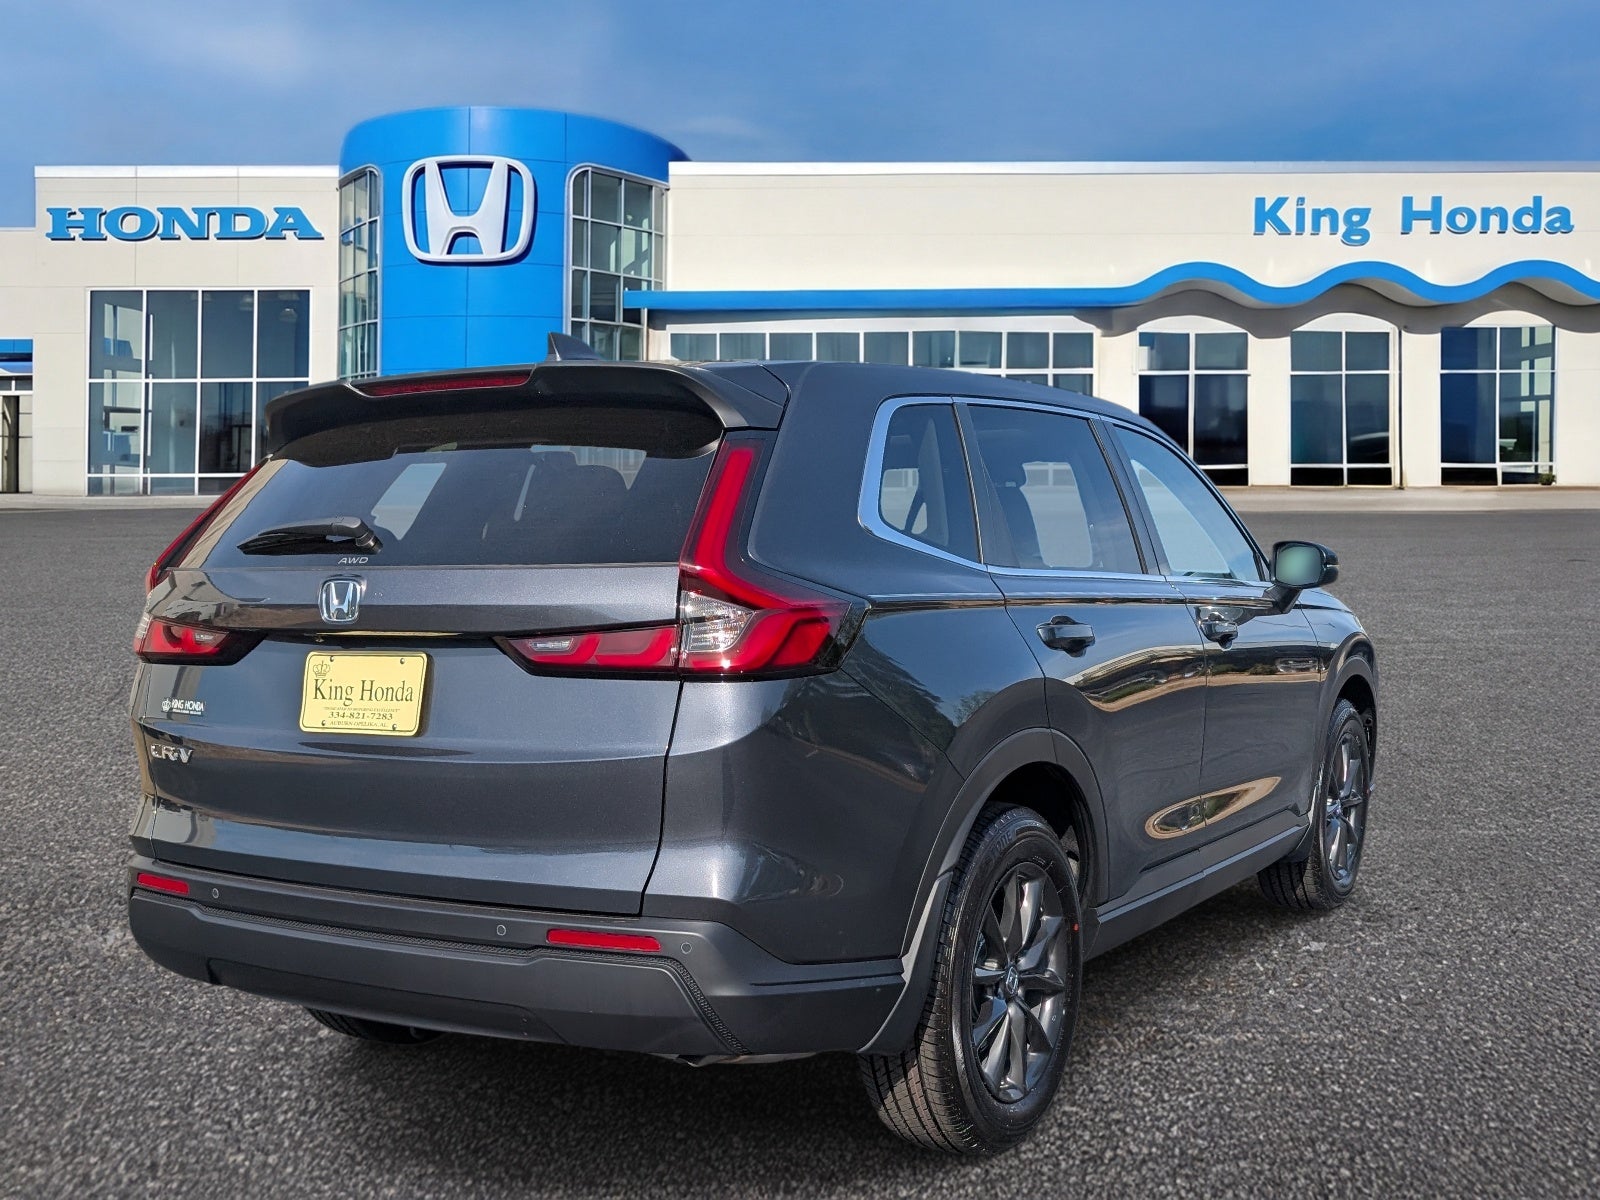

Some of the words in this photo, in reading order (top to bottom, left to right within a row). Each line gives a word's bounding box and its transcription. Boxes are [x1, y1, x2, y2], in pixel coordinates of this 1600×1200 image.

[45, 206, 324, 241] HONDA
[1253, 196, 1371, 246] King
[1401, 195, 1575, 235] Honda
[338, 556, 369, 565] AWD
[313, 678, 354, 707] King
[359, 679, 414, 702] Honda
[184, 700, 205, 712] HONDA
[328, 711, 393, 721] 334-821-7283
